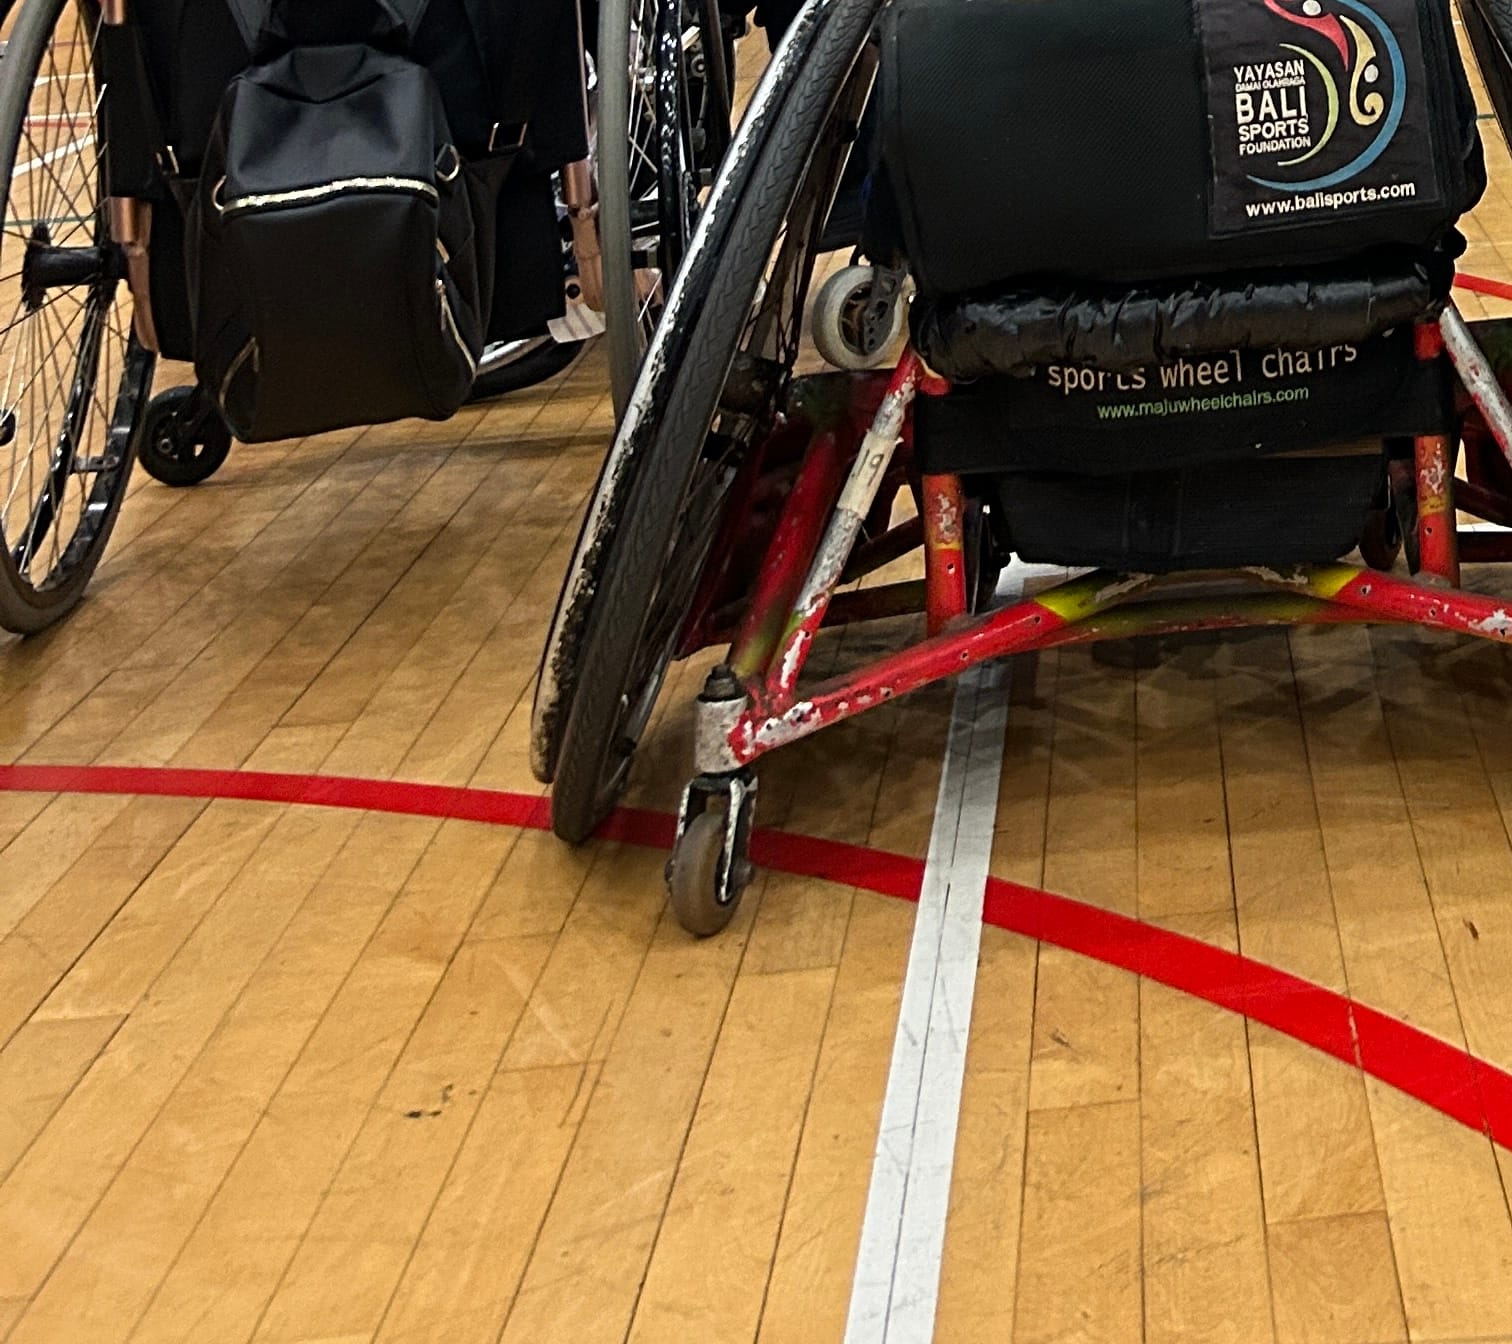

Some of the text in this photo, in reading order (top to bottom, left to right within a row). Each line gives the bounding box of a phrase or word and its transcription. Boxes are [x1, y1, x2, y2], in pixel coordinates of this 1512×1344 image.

[1233, 59, 1305, 83] YAYASAN
[1235, 85, 1308, 125] BALI
[1238, 117, 1310, 142] SPORTS
[1239, 135, 1312, 156] FOUNDATION
[1246, 181, 1416, 218] www.balisports.com
[1159, 348, 1243, 389] wheel
[1097, 386, 1310, 419] www.majuwheelchairs.com
